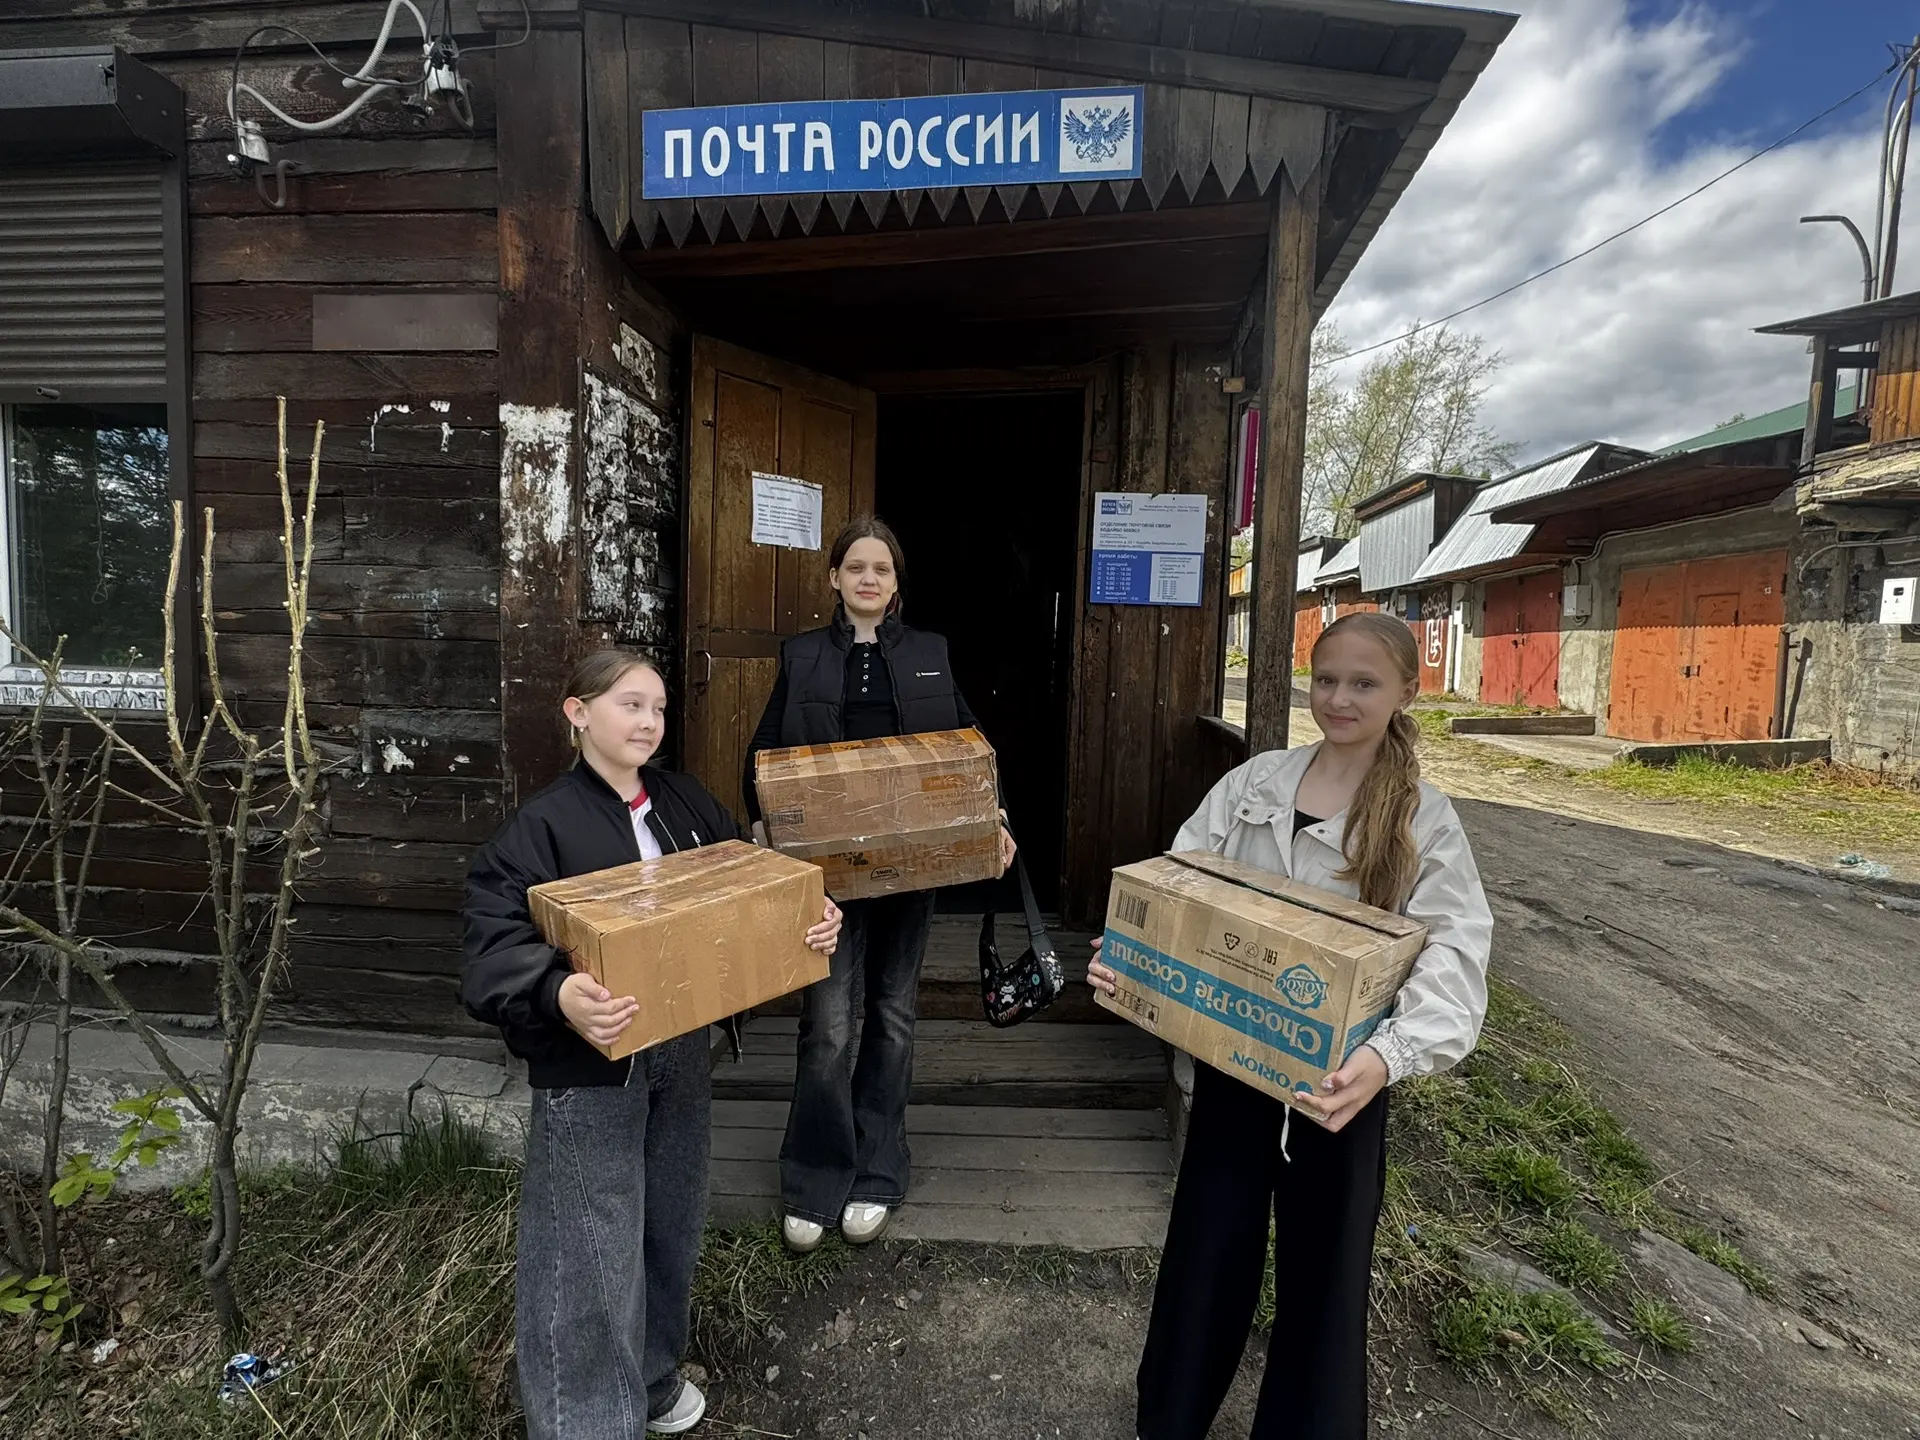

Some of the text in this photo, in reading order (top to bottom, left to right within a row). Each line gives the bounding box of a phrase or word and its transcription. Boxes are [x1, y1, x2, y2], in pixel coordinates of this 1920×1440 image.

[664, 110, 1040, 178] ПОЧТА РОССИИ
[1108, 939, 1188, 994] Coconut
[1231, 1050, 1291, 1089] ORION
